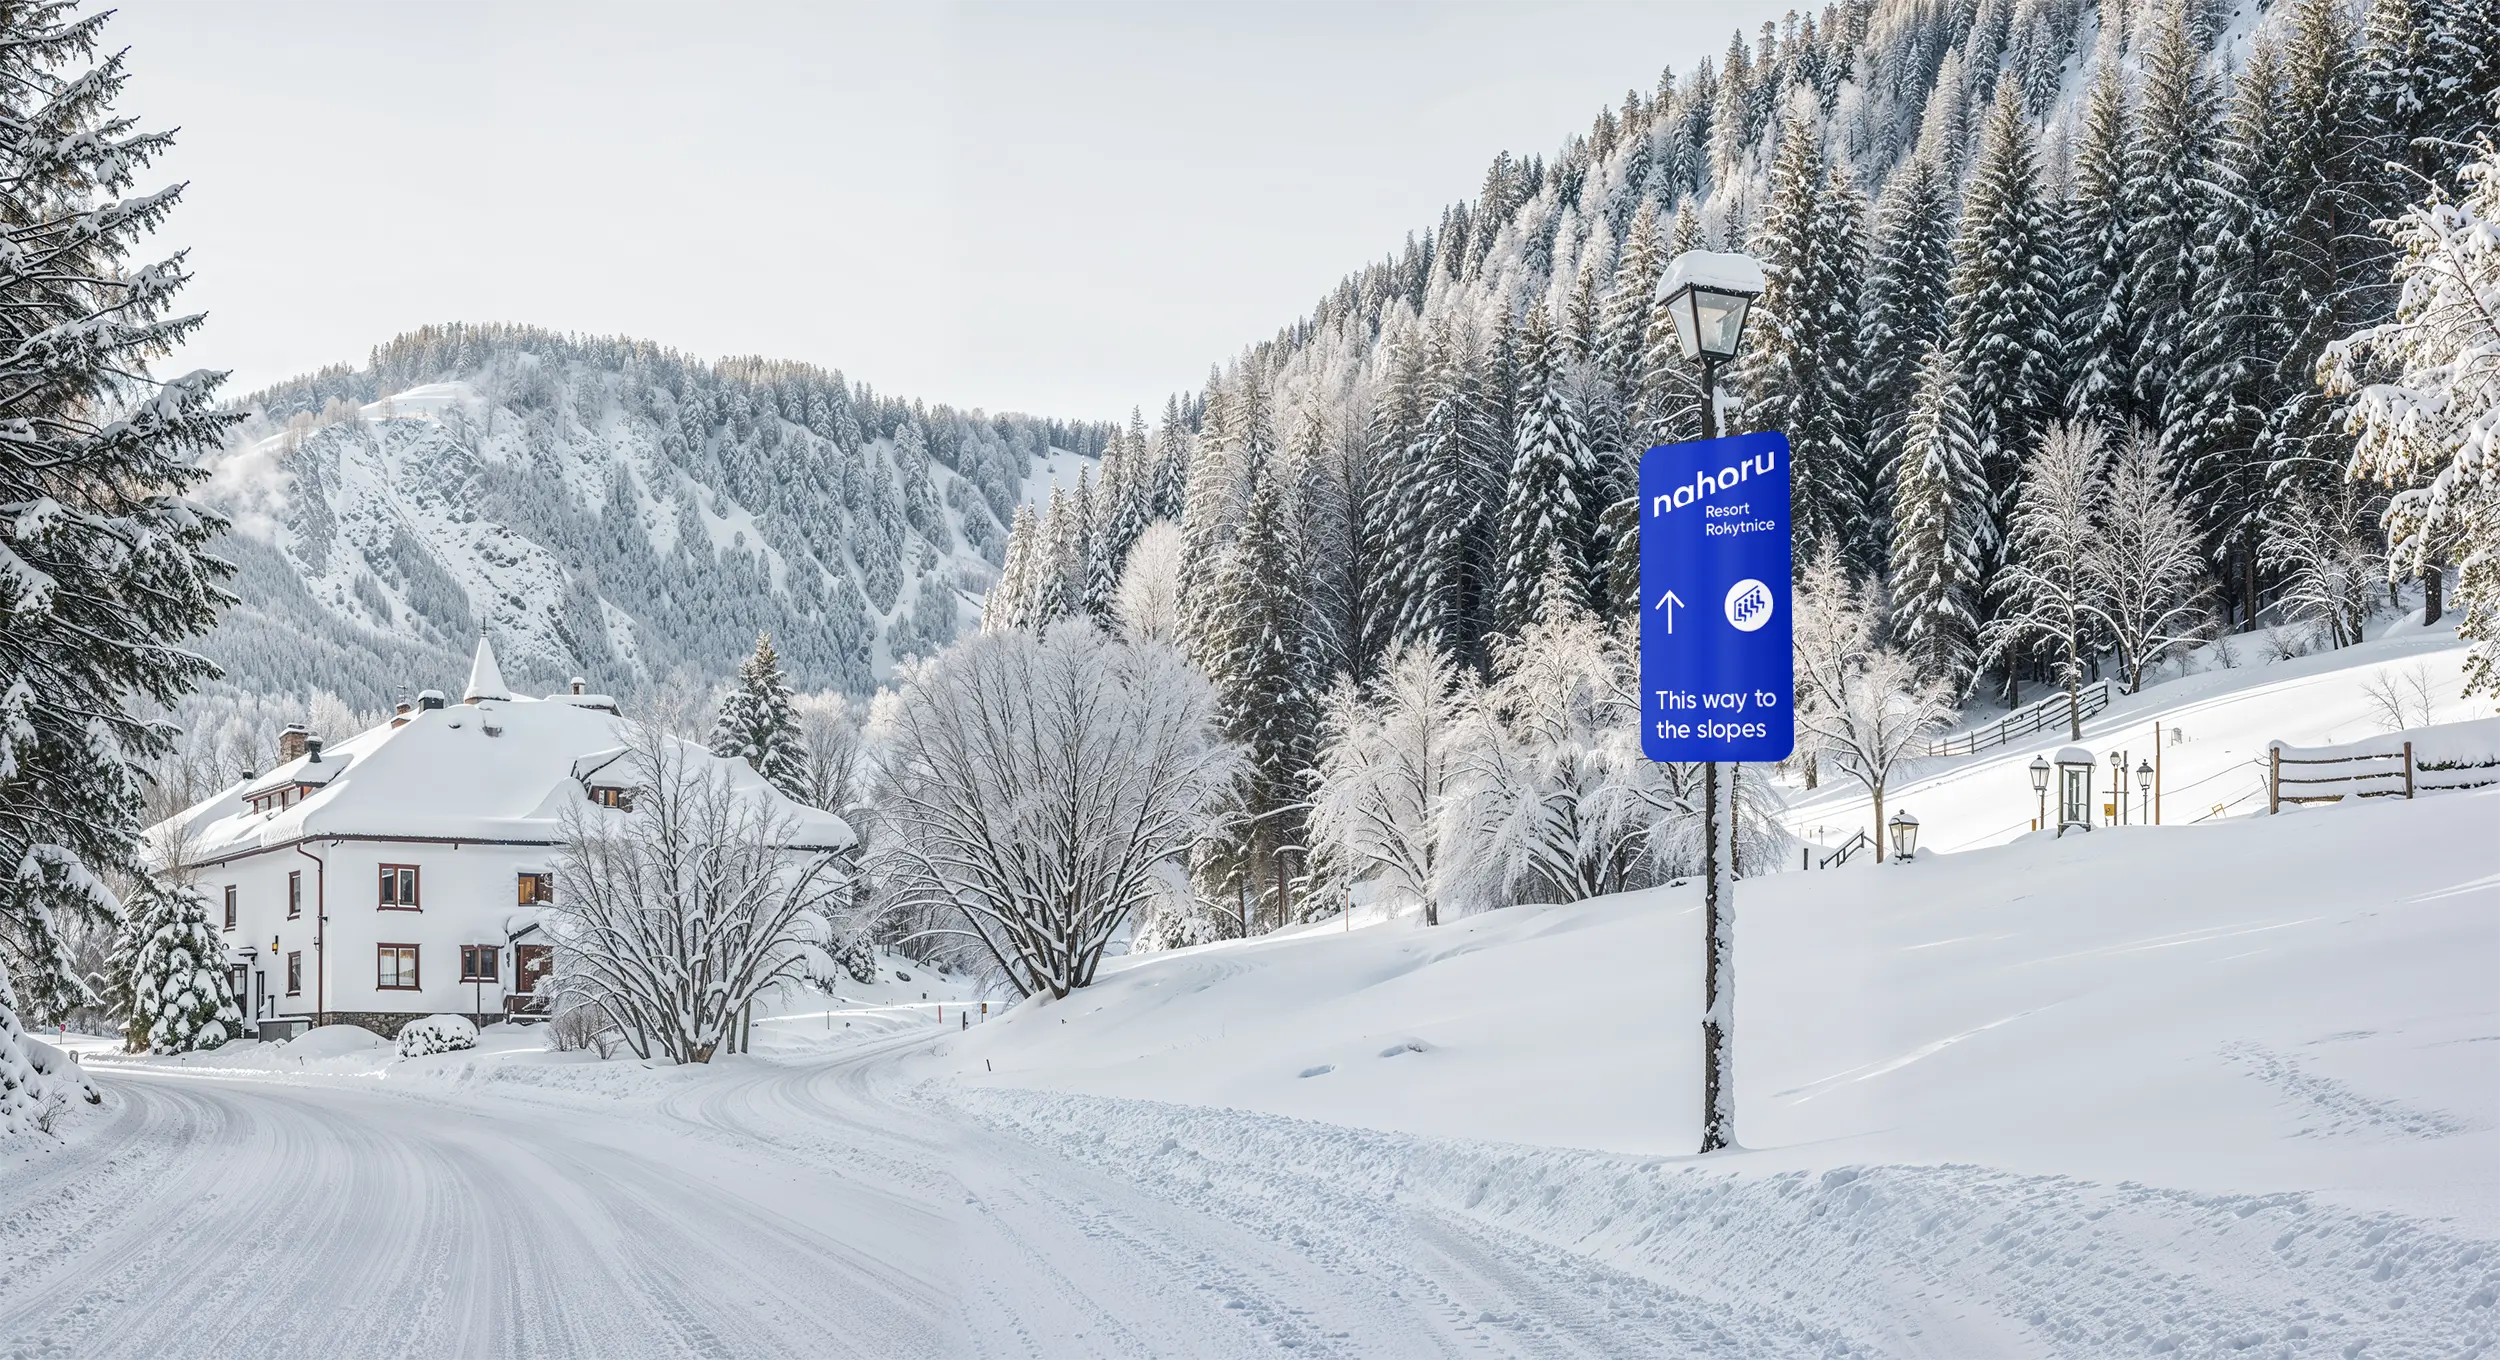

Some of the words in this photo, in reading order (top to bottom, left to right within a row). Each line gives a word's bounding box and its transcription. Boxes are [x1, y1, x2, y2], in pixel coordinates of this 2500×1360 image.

[1653, 451, 1775, 517] nahoru
[1706, 502, 1750, 518] Resort
[1706, 518, 1776, 536] Rokytnice
[1655, 690, 1697, 710] This
[1702, 692, 1748, 713] way
[1754, 689, 1777, 708] to
[1655, 719, 1691, 739] the
[1697, 719, 1767, 743] slopes
